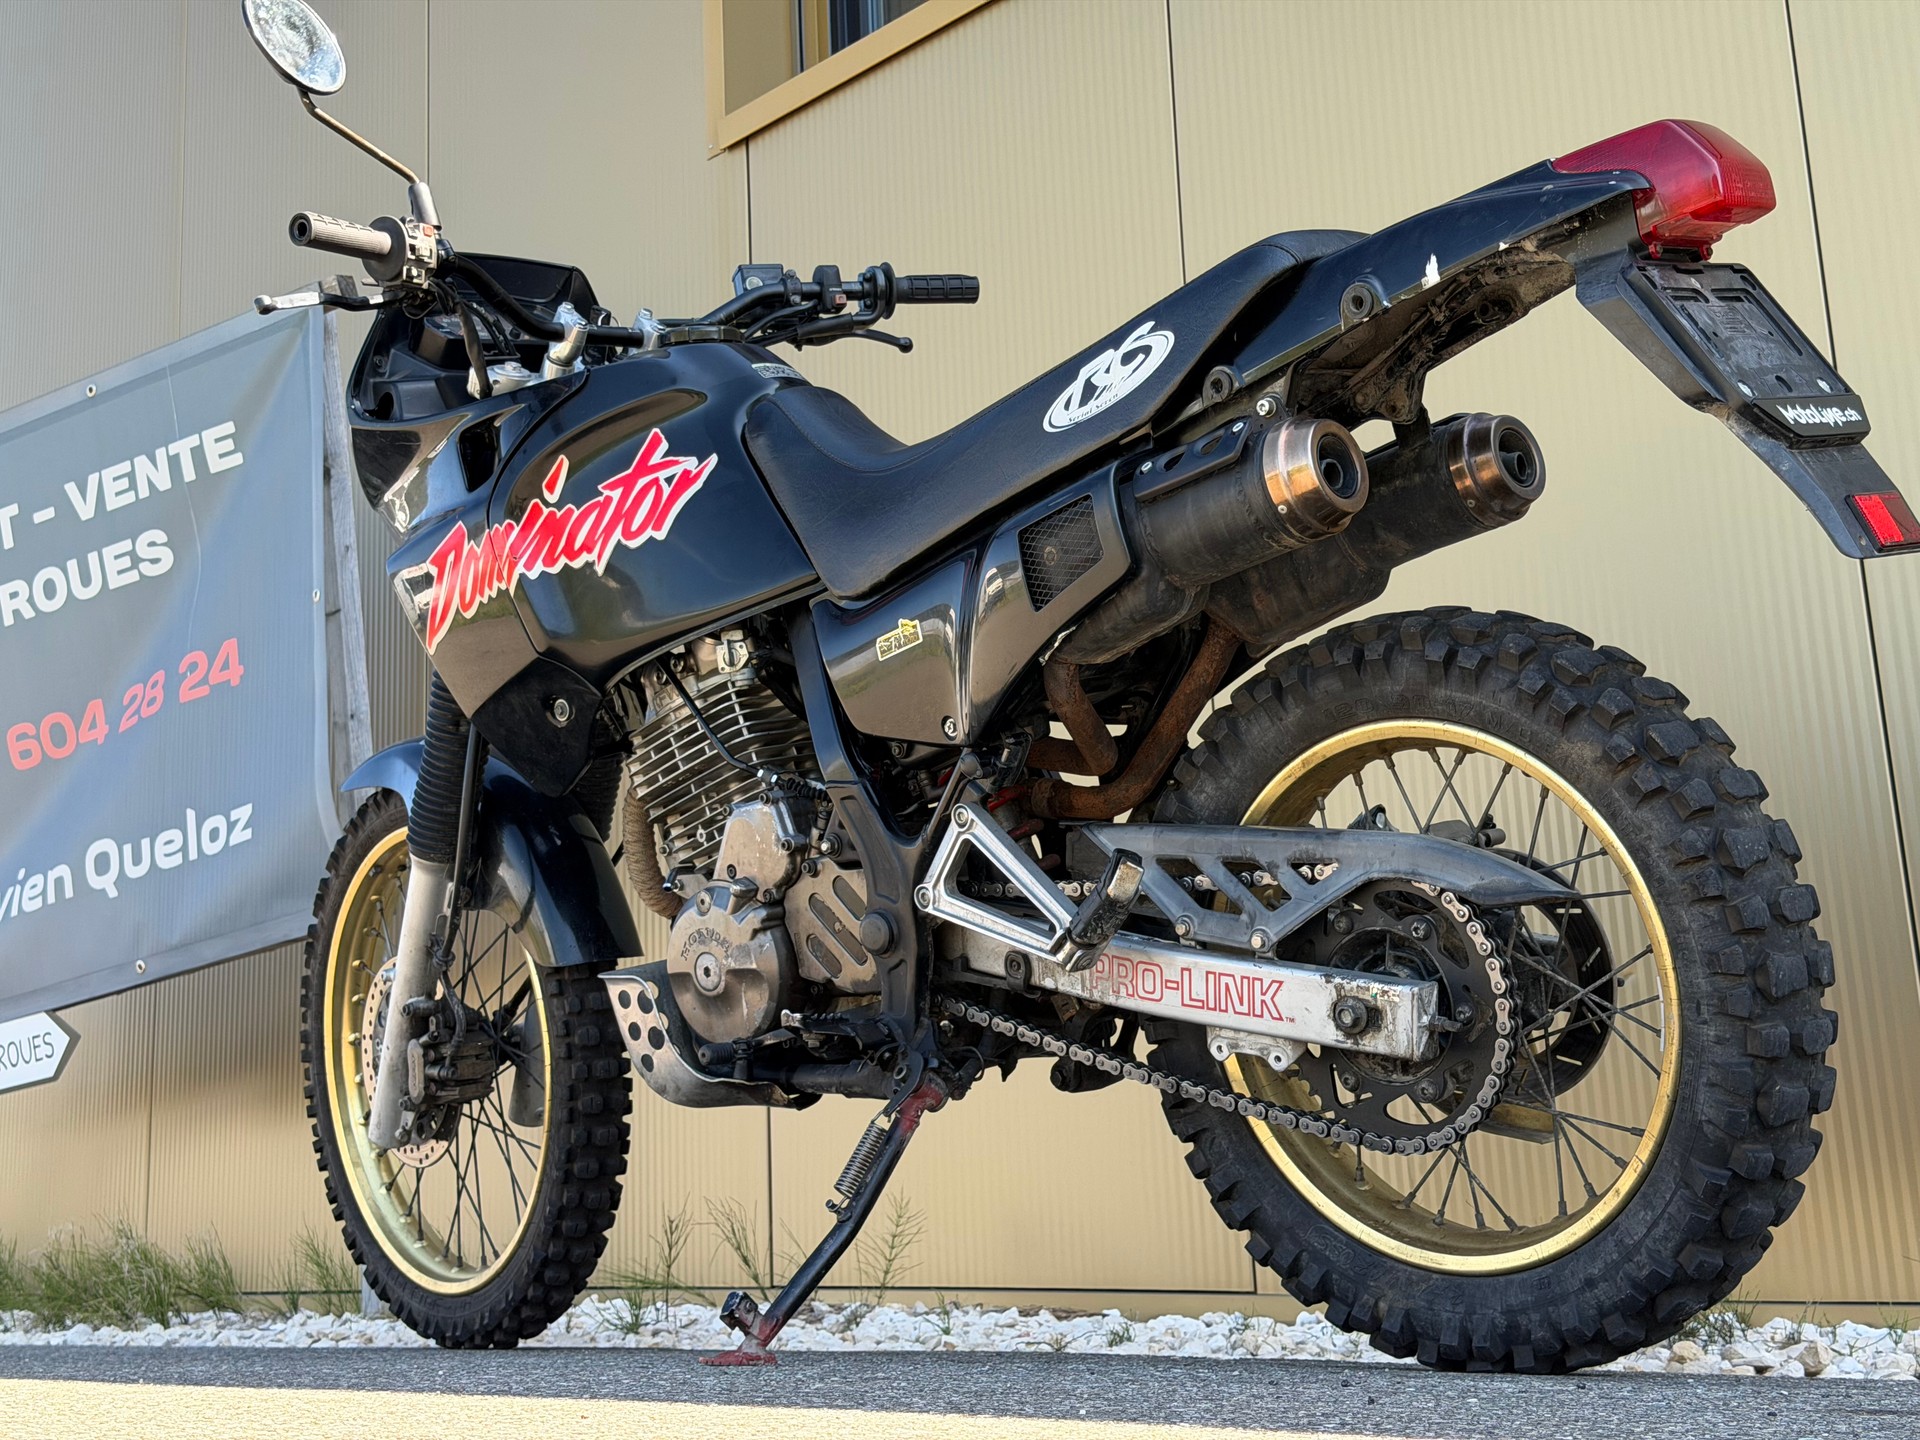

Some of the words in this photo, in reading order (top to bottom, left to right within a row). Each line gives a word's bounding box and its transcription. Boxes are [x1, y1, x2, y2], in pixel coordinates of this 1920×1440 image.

[64, 420, 244, 521] VENTE
[0, 528, 174, 627] ROUES
[426, 427, 718, 656] Dominator
[6, 698, 109, 771] 604
[118, 669, 165, 733] 28
[178, 637, 244, 703] 24
[85, 802, 253, 899] Queloz
[1090, 953, 1284, 1022] PRO-LINK
[0, 1031, 55, 1070] ROUES
